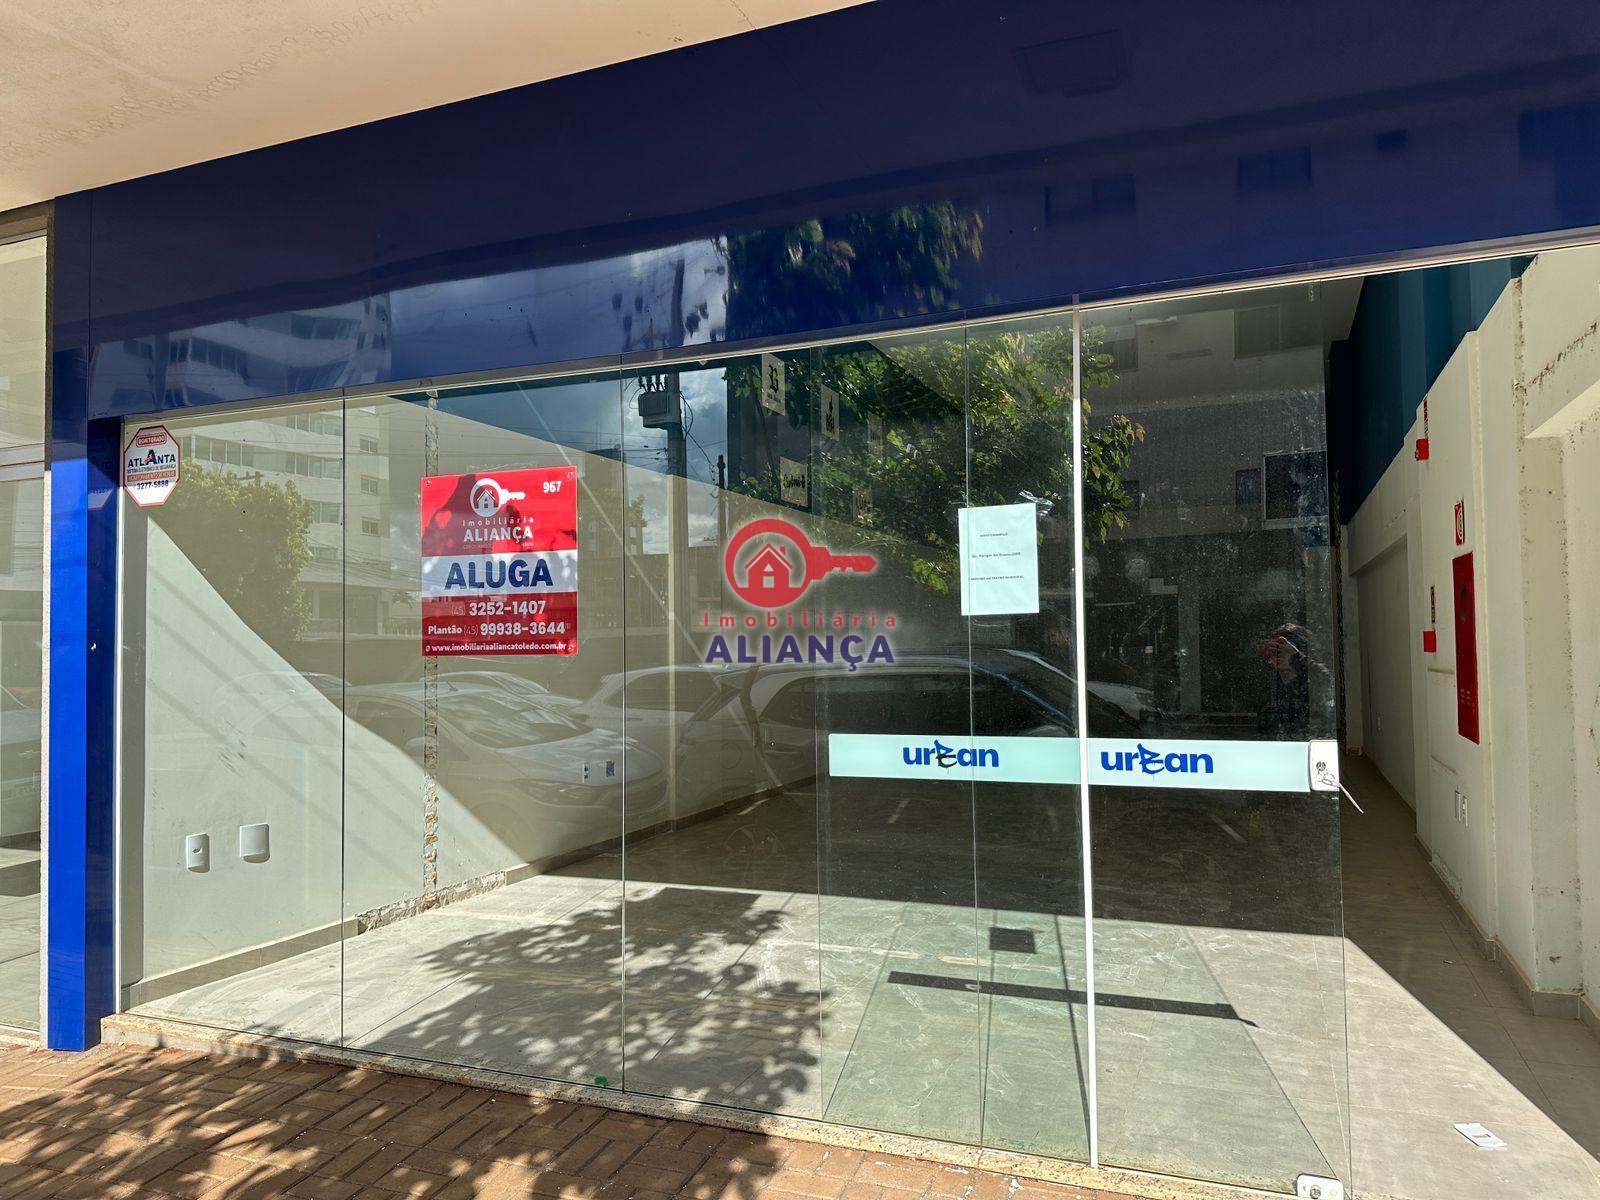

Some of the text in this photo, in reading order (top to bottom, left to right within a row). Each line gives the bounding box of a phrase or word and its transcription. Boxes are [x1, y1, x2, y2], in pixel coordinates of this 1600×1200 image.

[127, 449, 176, 467] ATLANTA
[543, 481, 562, 493] 967
[462, 515, 535, 527] Imobiliária
[463, 526, 534, 544] ALIANÇA
[444, 559, 554, 590] ALUGA
[469, 600, 546, 616] 3252-1407
[428, 621, 566, 636] Plantão (45) 99938-3644
[432, 641, 567, 652] www.imobiliariaaliancatoledo.com.br
